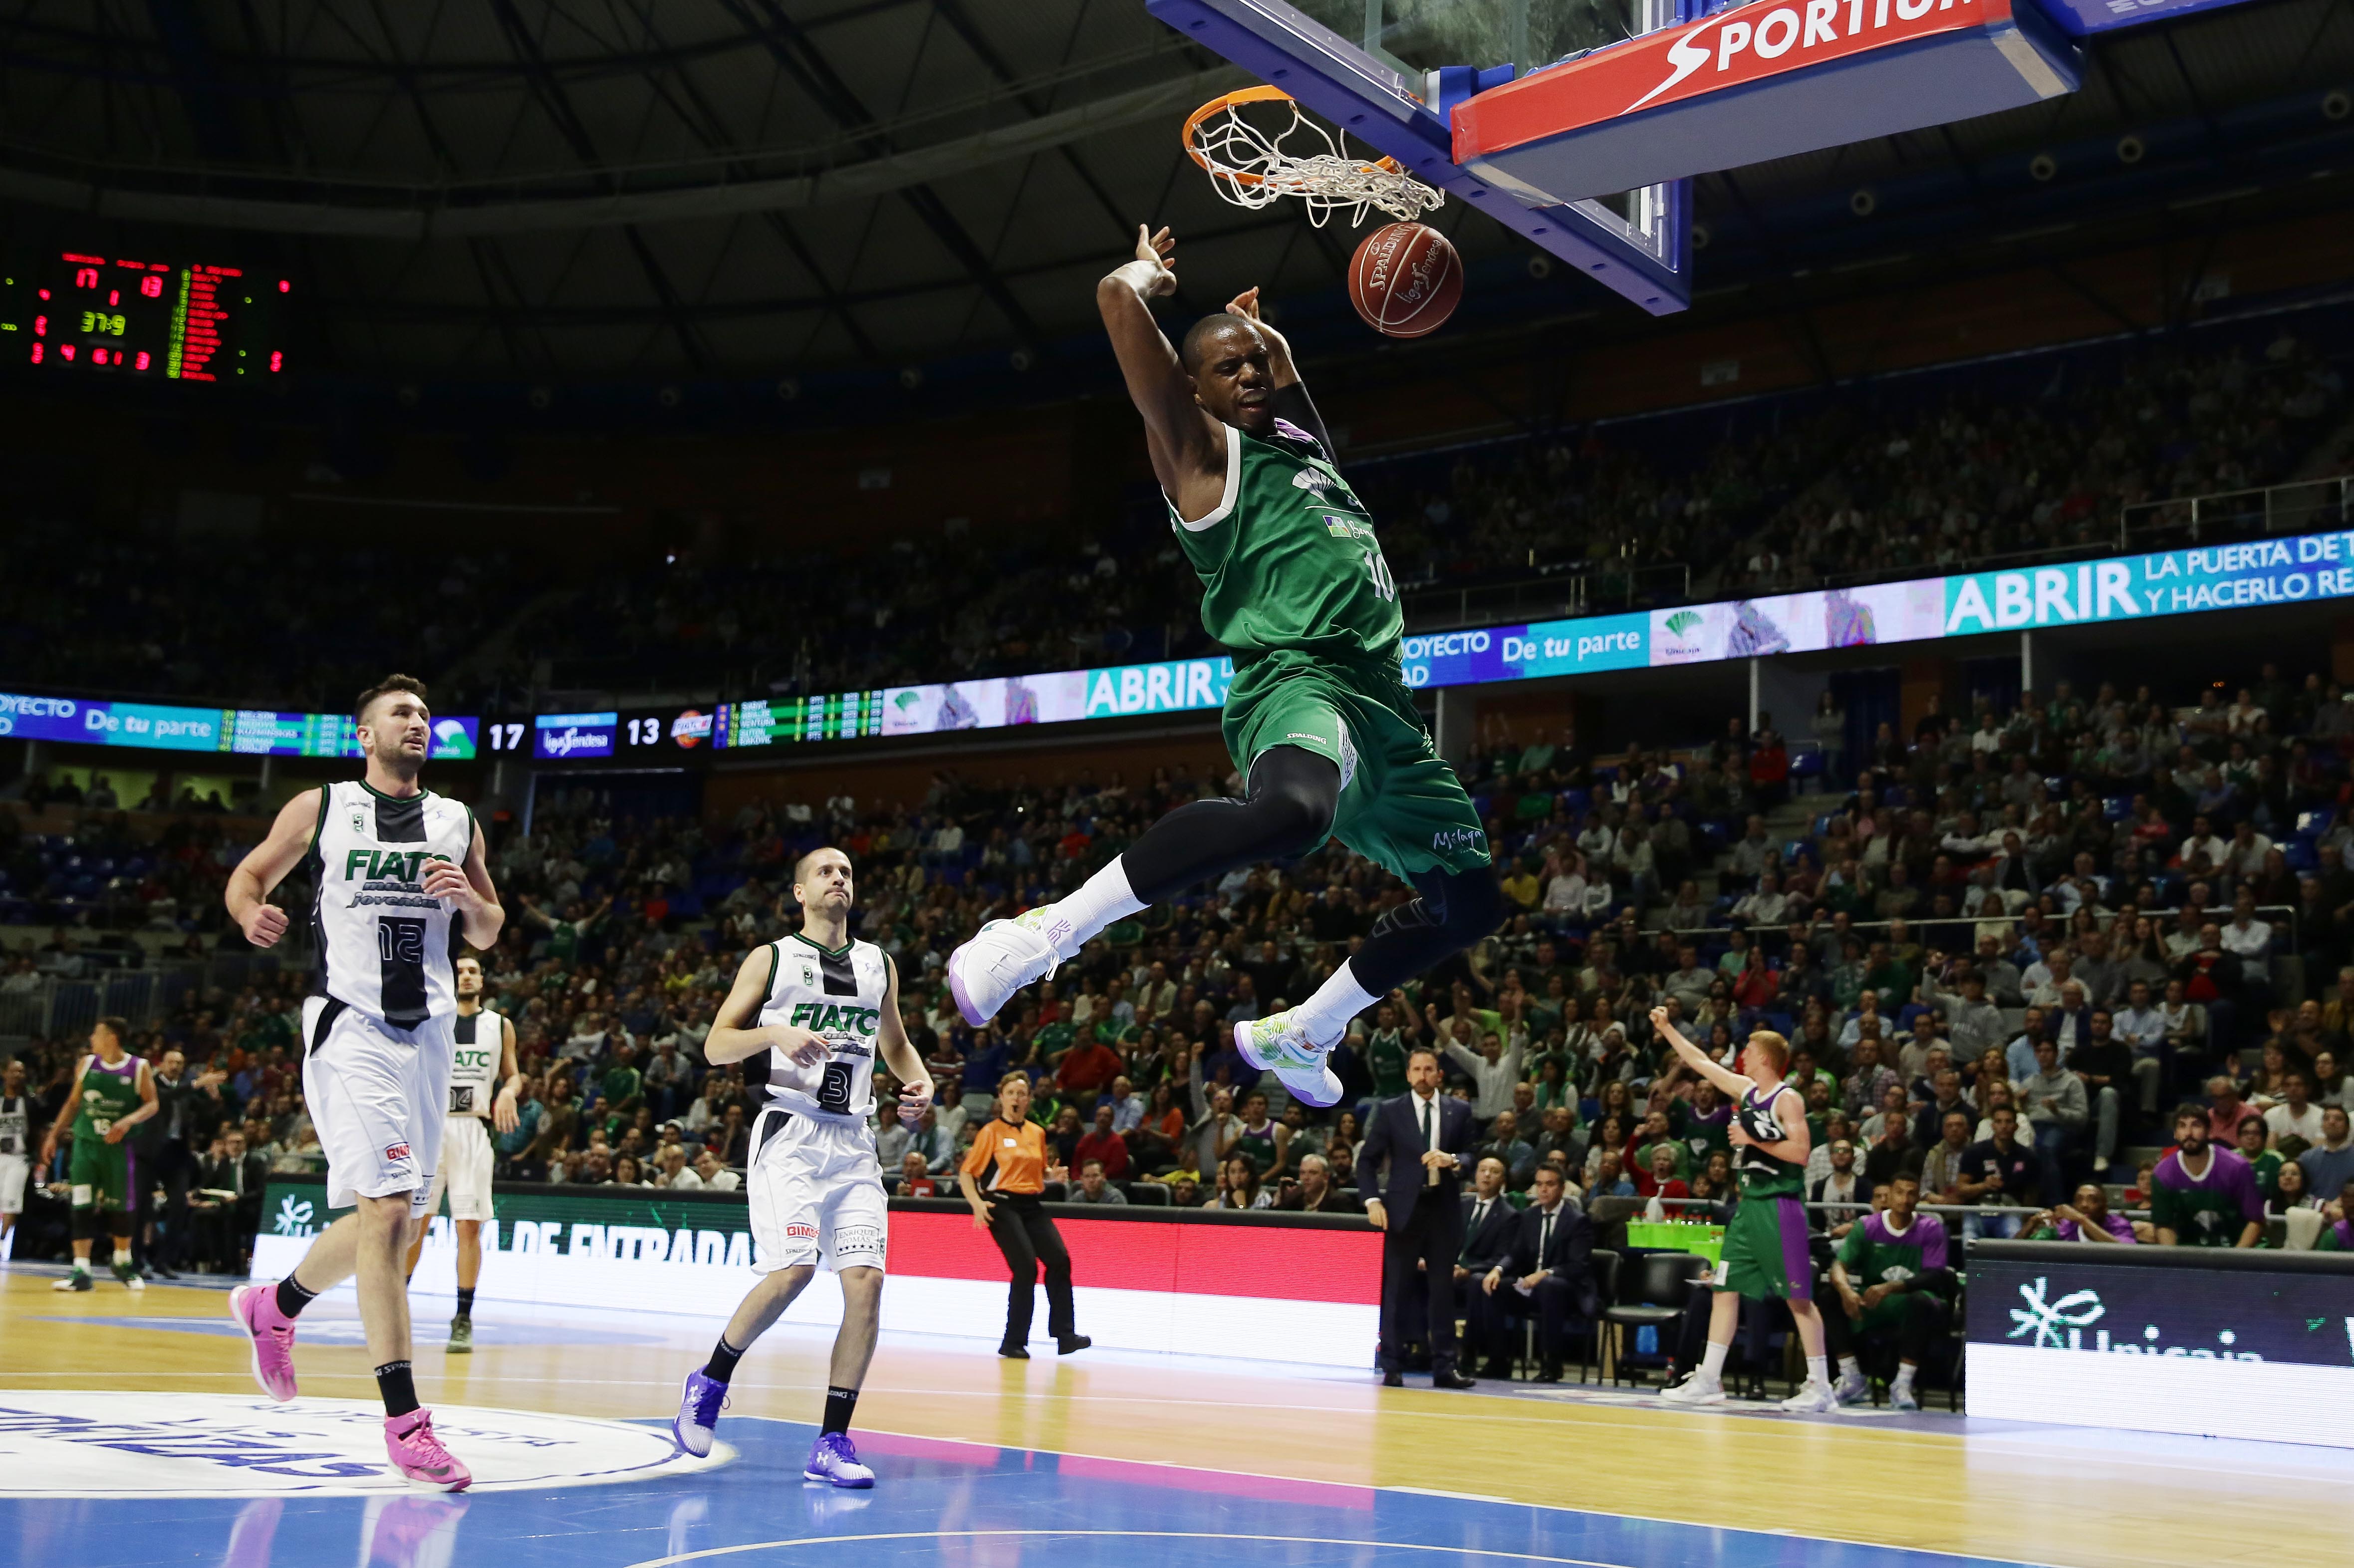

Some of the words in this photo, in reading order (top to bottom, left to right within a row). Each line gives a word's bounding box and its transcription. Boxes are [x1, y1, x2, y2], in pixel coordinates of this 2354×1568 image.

[1617, 0, 1975, 116] SPORTI
[1369, 224, 1418, 291] SPALDING
[2143, 554, 2180, 581] LA
[2186, 540, 2292, 575] PUERTA
[2298, 535, 2340, 563] DE
[1364, 550, 1395, 603] 10
[2145, 588, 2164, 613] Y
[2171, 573, 2310, 611] HACERLO
[1945, 562, 2141, 632] ABRIR
[1503, 637, 1537, 662] De
[1544, 637, 1570, 658] tu
[1577, 630, 1641, 662] parte
[1086, 662, 1216, 714] ABRIR
[85, 709, 119, 732] De
[124, 716, 150, 733] tu
[154, 717, 212, 739] parte
[490, 724, 525, 750] 17
[627, 718, 660, 746] 13
[1287, 732, 1327, 745] SPALDING
[379, 923, 426, 963] 12
[790, 1003, 880, 1037] FIATC
[455, 1051, 491, 1067] ATC
[822, 1068, 849, 1104] 3
[839, 1229, 875, 1239] ENRIQUE
